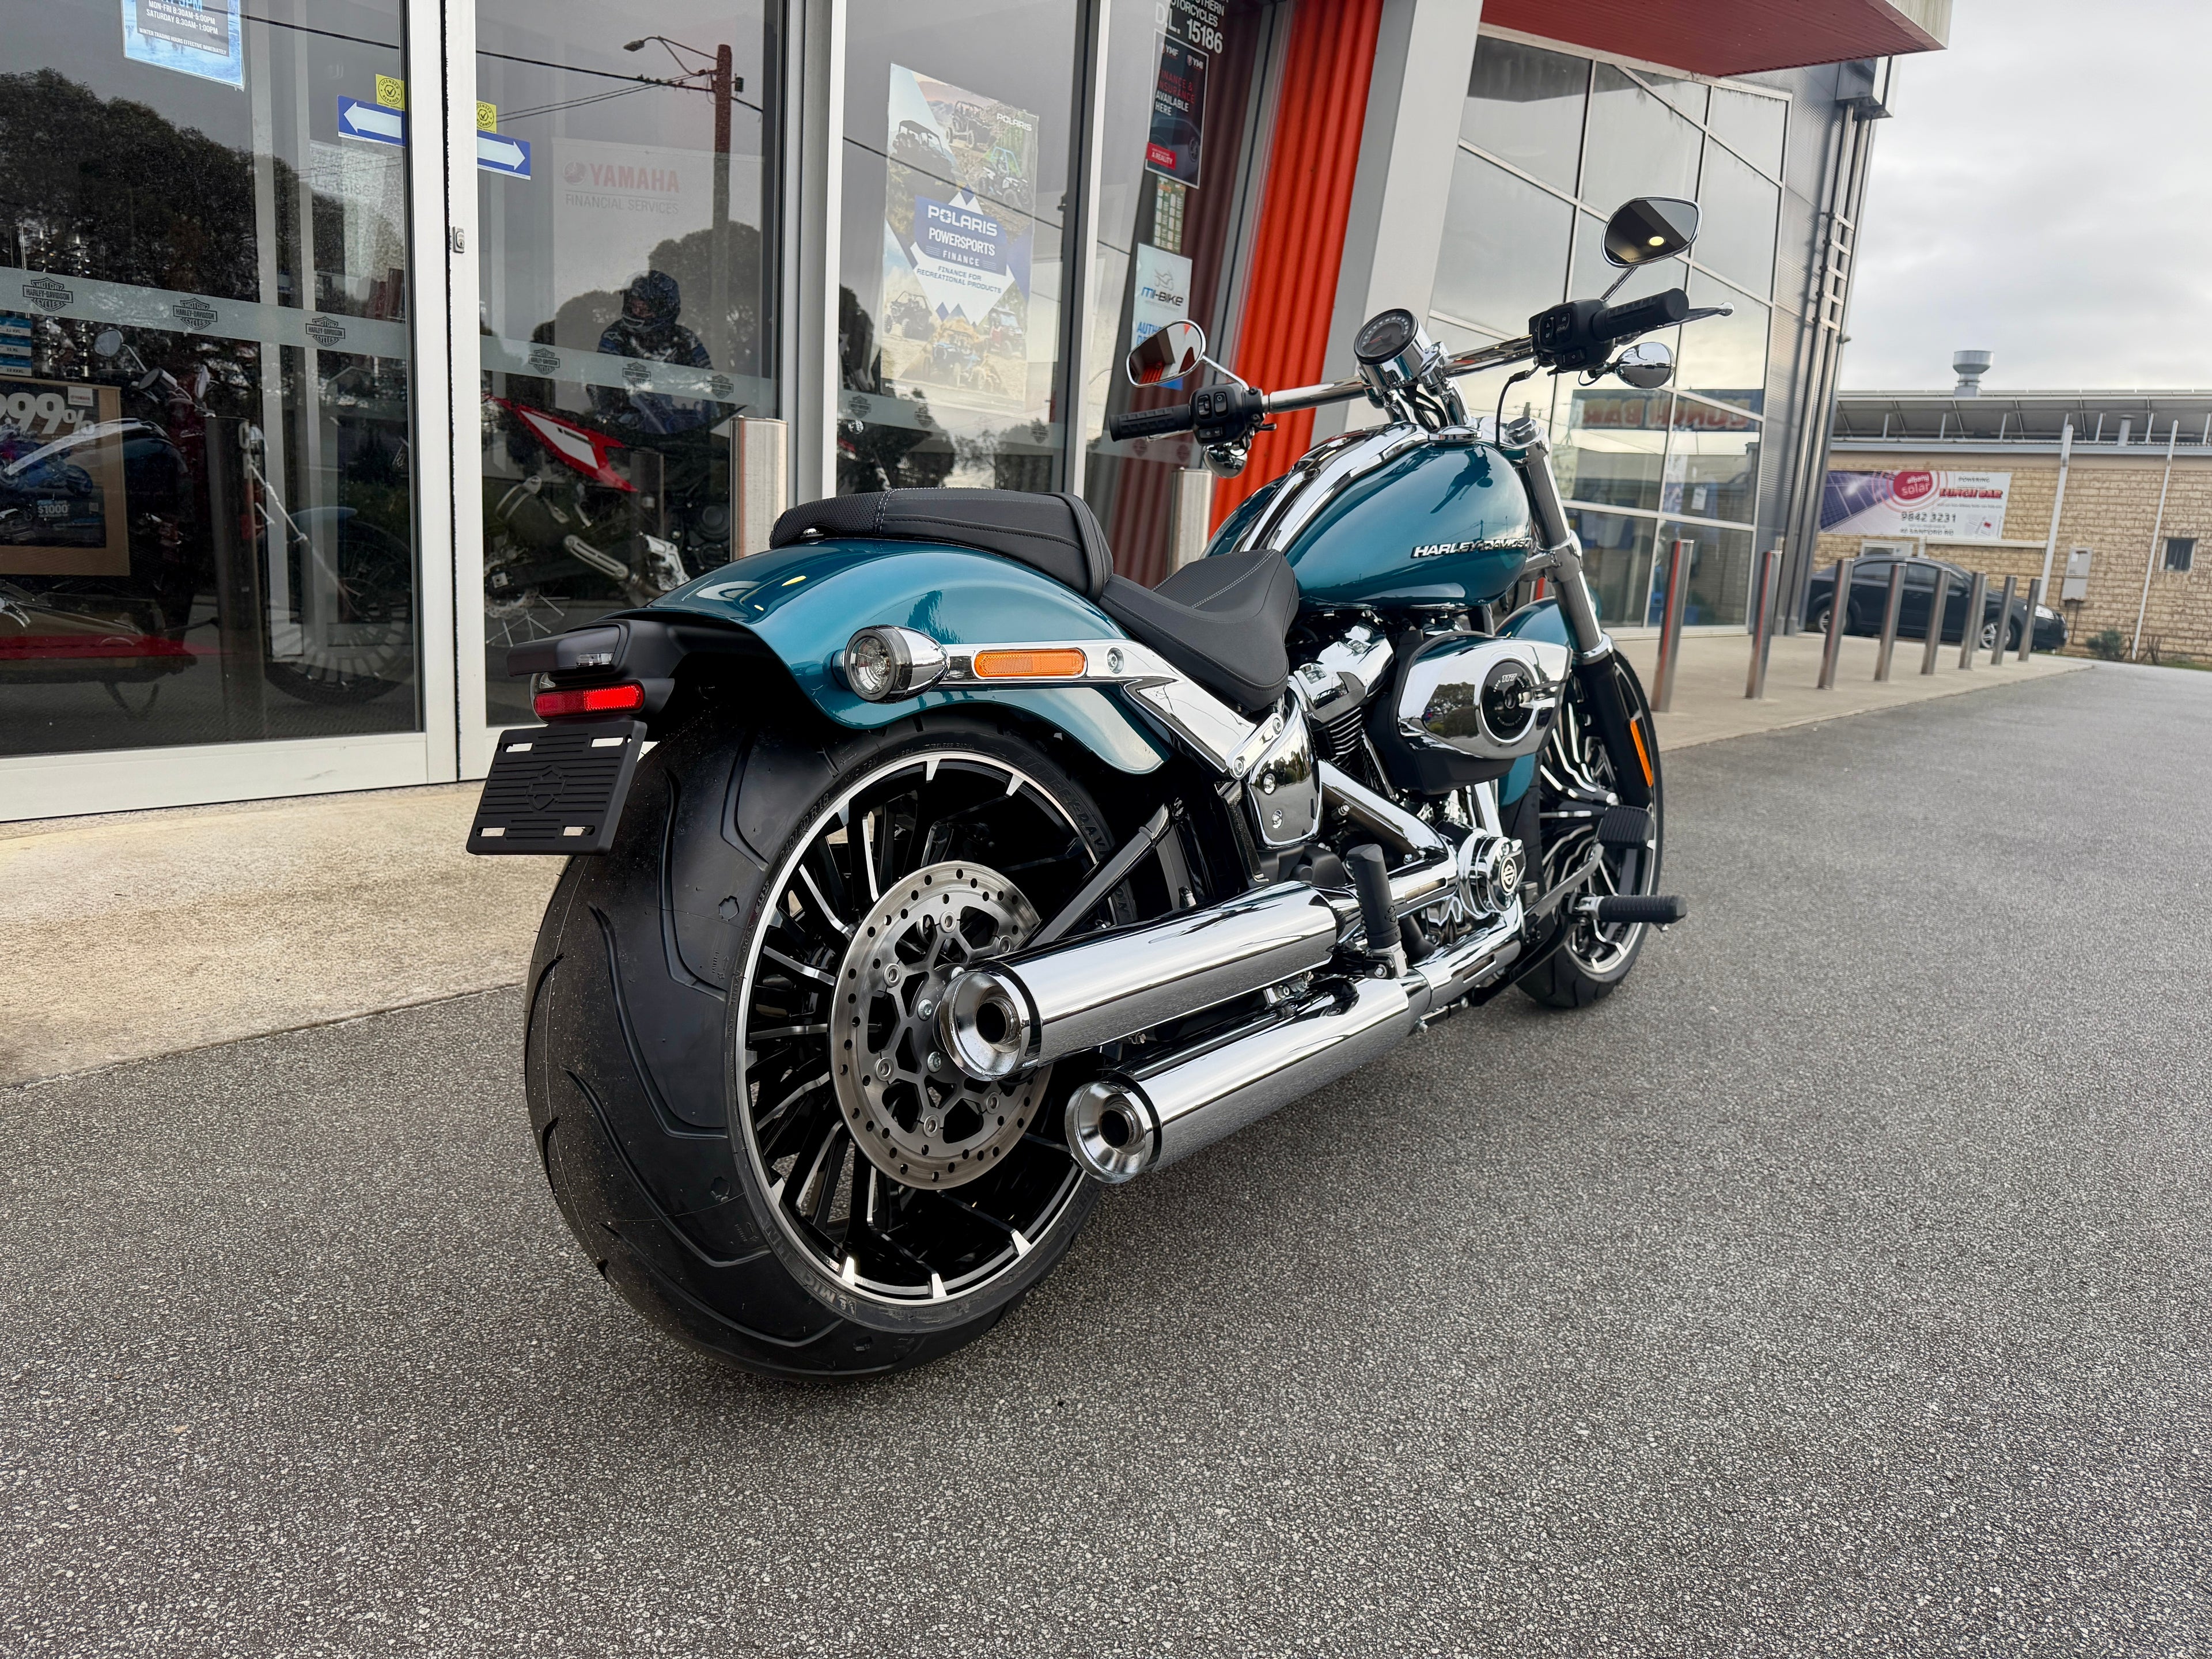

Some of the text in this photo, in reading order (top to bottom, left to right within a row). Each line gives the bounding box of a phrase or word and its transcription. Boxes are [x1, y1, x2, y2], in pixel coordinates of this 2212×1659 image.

[149, 0, 215, 25] MON-FRI 8:30AM-5:00PM
[146, 9, 218, 35] SATURDAY 8:30AM-1:00PM
[139, 27, 154, 36] WINTER
[154, 31, 171, 40] TRADING
[171, 34, 183, 44] HOURS
[183, 37, 202, 49] EFFECTIVE
[1187, 18, 1224, 54] 15186
[1159, 68, 1194, 92] INANCE &
[1154, 101, 1172, 116] HERE
[1155, 90, 1190, 112] AVAILABLE
[997, 112, 1032, 131] POLARIS
[589, 162, 680, 194] YAMAHA
[566, 194, 679, 215] FINANCIAL SERVICES
[927, 204, 998, 237] POLARIS
[929, 227, 995, 256] POWERSPORTS
[942, 250, 980, 267] FINANCE
[917, 268, 1002, 294] RECREATIONAL PRODUCTS
[937, 266, 982, 281] FINANCE FOR
[36, 281, 59, 290] MOTOR
[25, 288, 70, 301] HARLEY-DAVIDSON
[36, 298, 63, 309] CYCLES
[175, 308, 215, 320] HARLEY-DAVIDSON
[308, 326, 343, 336] HARLEY-DAVIDSON
[1907, 474, 1929, 484] albany
[1901, 482, 1930, 497] solar
[1939, 488, 2003, 499] LUNCH BAR
[1901, 511, 1957, 523] 9842 3231
[1502, 673, 1517, 683] 117
